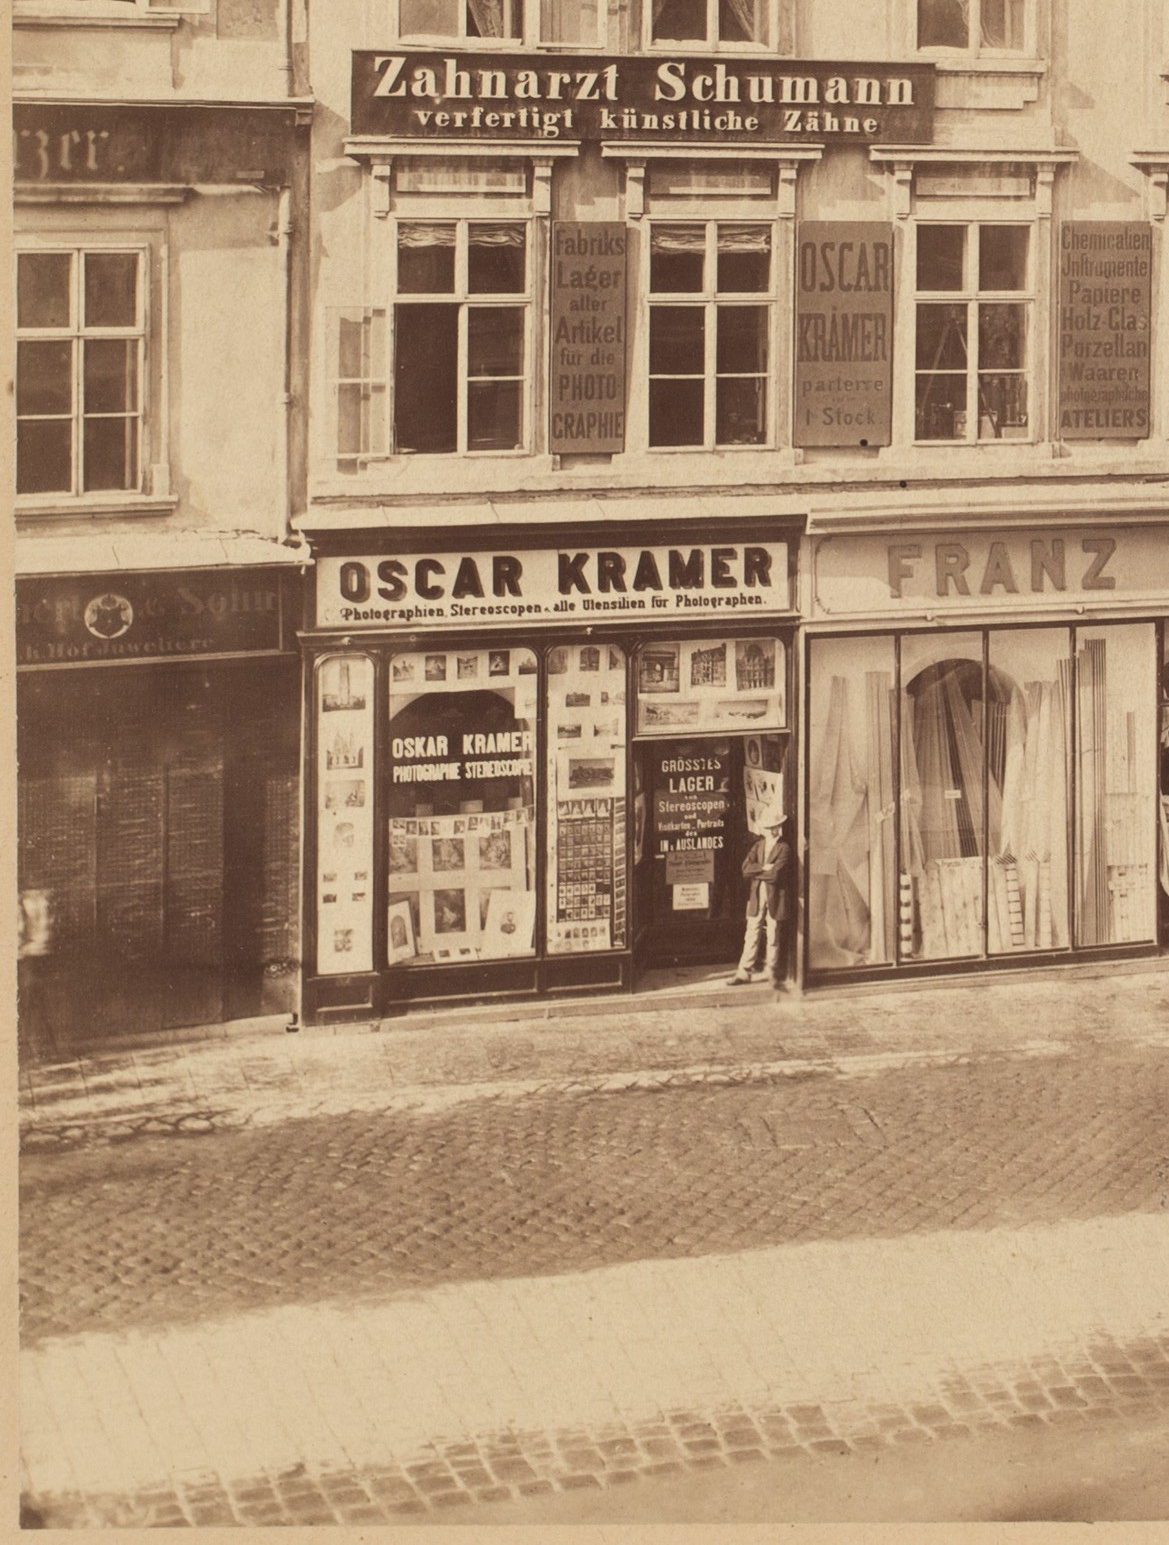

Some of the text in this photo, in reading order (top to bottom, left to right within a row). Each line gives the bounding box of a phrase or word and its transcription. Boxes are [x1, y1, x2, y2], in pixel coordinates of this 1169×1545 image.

[373, 56, 915, 105] Zahnarzt Schumann
[414, 107, 878, 138] verfertigt künstliche Zähne
[556, 261, 622, 292] Lager
[801, 242, 890, 292] OSCAR
[570, 294, 607, 312] aller
[1069, 280, 1141, 306] Papiere
[555, 316, 623, 345] Artikel
[1062, 334, 1147, 357] Porzellan
[1061, 408, 1147, 428] ATELIERS
[340, 547, 773, 604] OSCAR KRAMER
[888, 538, 1118, 599] FRANZ
[450, 603, 542, 617] Stereoscopen
[553, 600, 576, 612] alle
[392, 730, 536, 759] OSKAR KRAMER
[669, 776, 714, 793] LAGER
